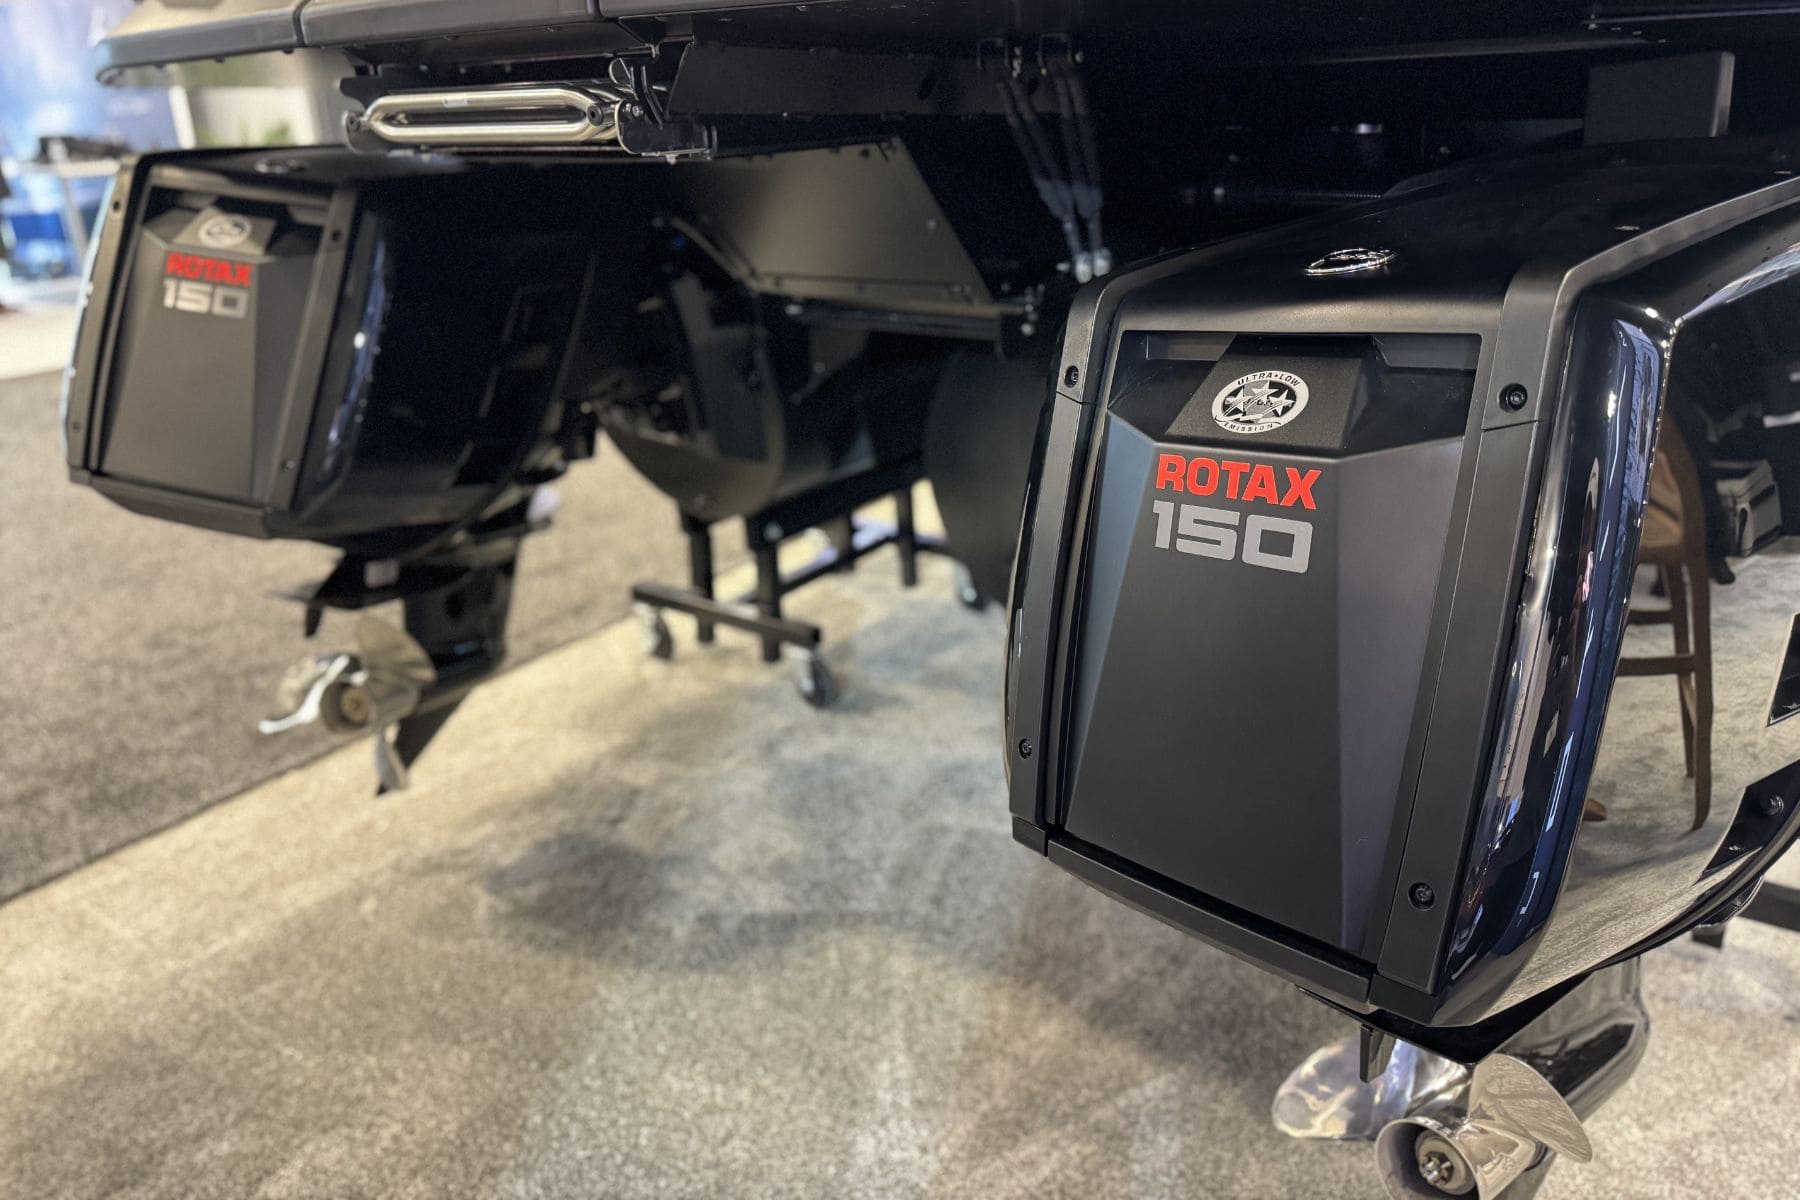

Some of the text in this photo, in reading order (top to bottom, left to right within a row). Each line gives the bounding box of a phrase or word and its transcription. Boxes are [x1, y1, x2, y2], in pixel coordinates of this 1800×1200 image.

[166, 250, 253, 288] ROTAX
[163, 276, 249, 319] 150
[1223, 421, 1274, 433] EMISSION
[1155, 453, 1322, 510] ROTAX
[1152, 499, 1314, 574] 150
